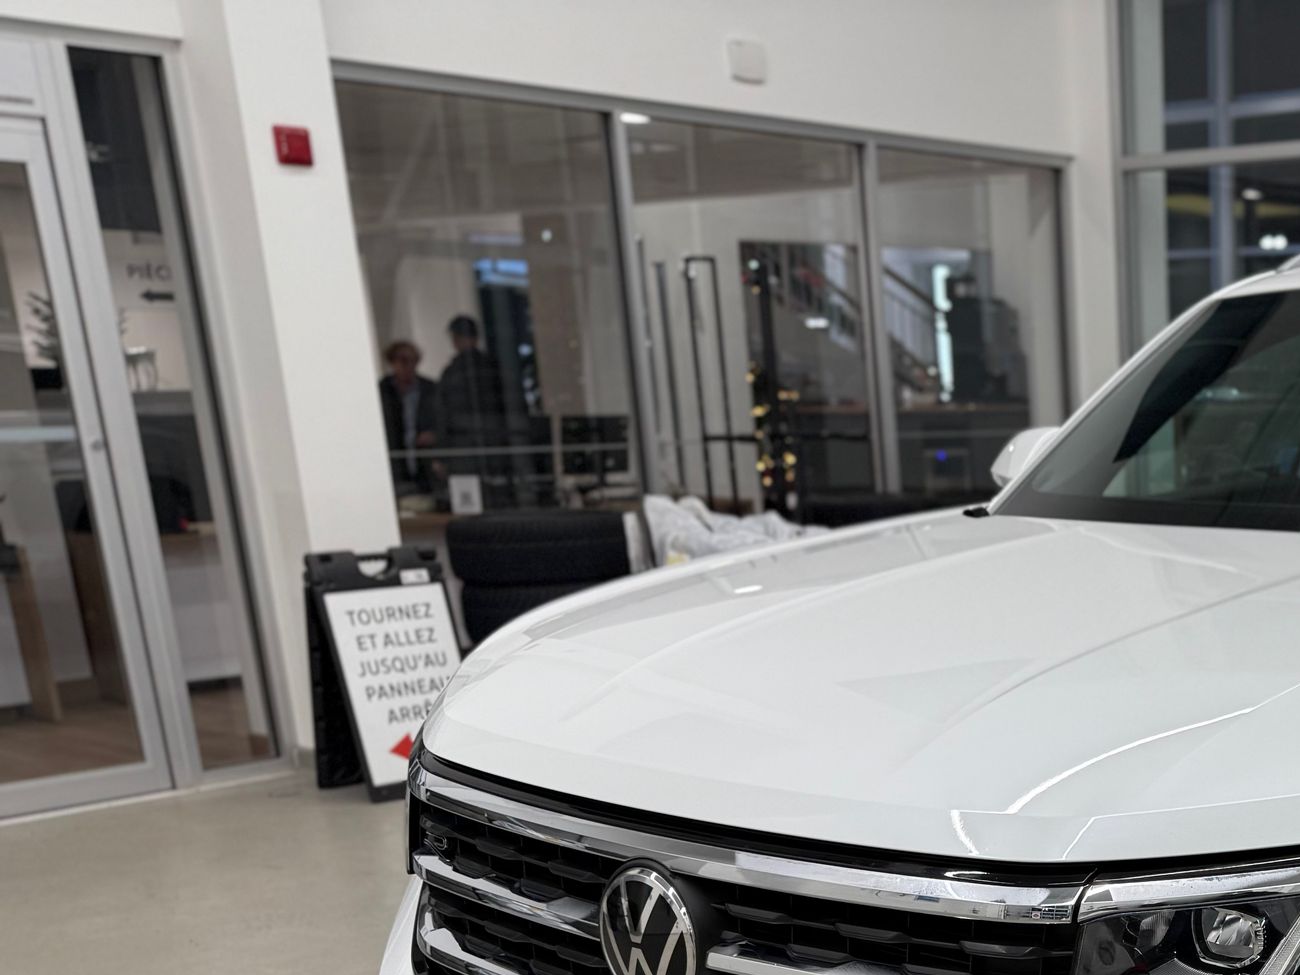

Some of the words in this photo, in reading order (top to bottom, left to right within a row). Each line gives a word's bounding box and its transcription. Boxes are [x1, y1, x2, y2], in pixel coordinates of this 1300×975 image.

[346, 602, 434, 627] TOURNEZ
[356, 633, 377, 652] ET
[382, 627, 438, 648] ALLEZ
[357, 651, 448, 678] JUSQU'AU
